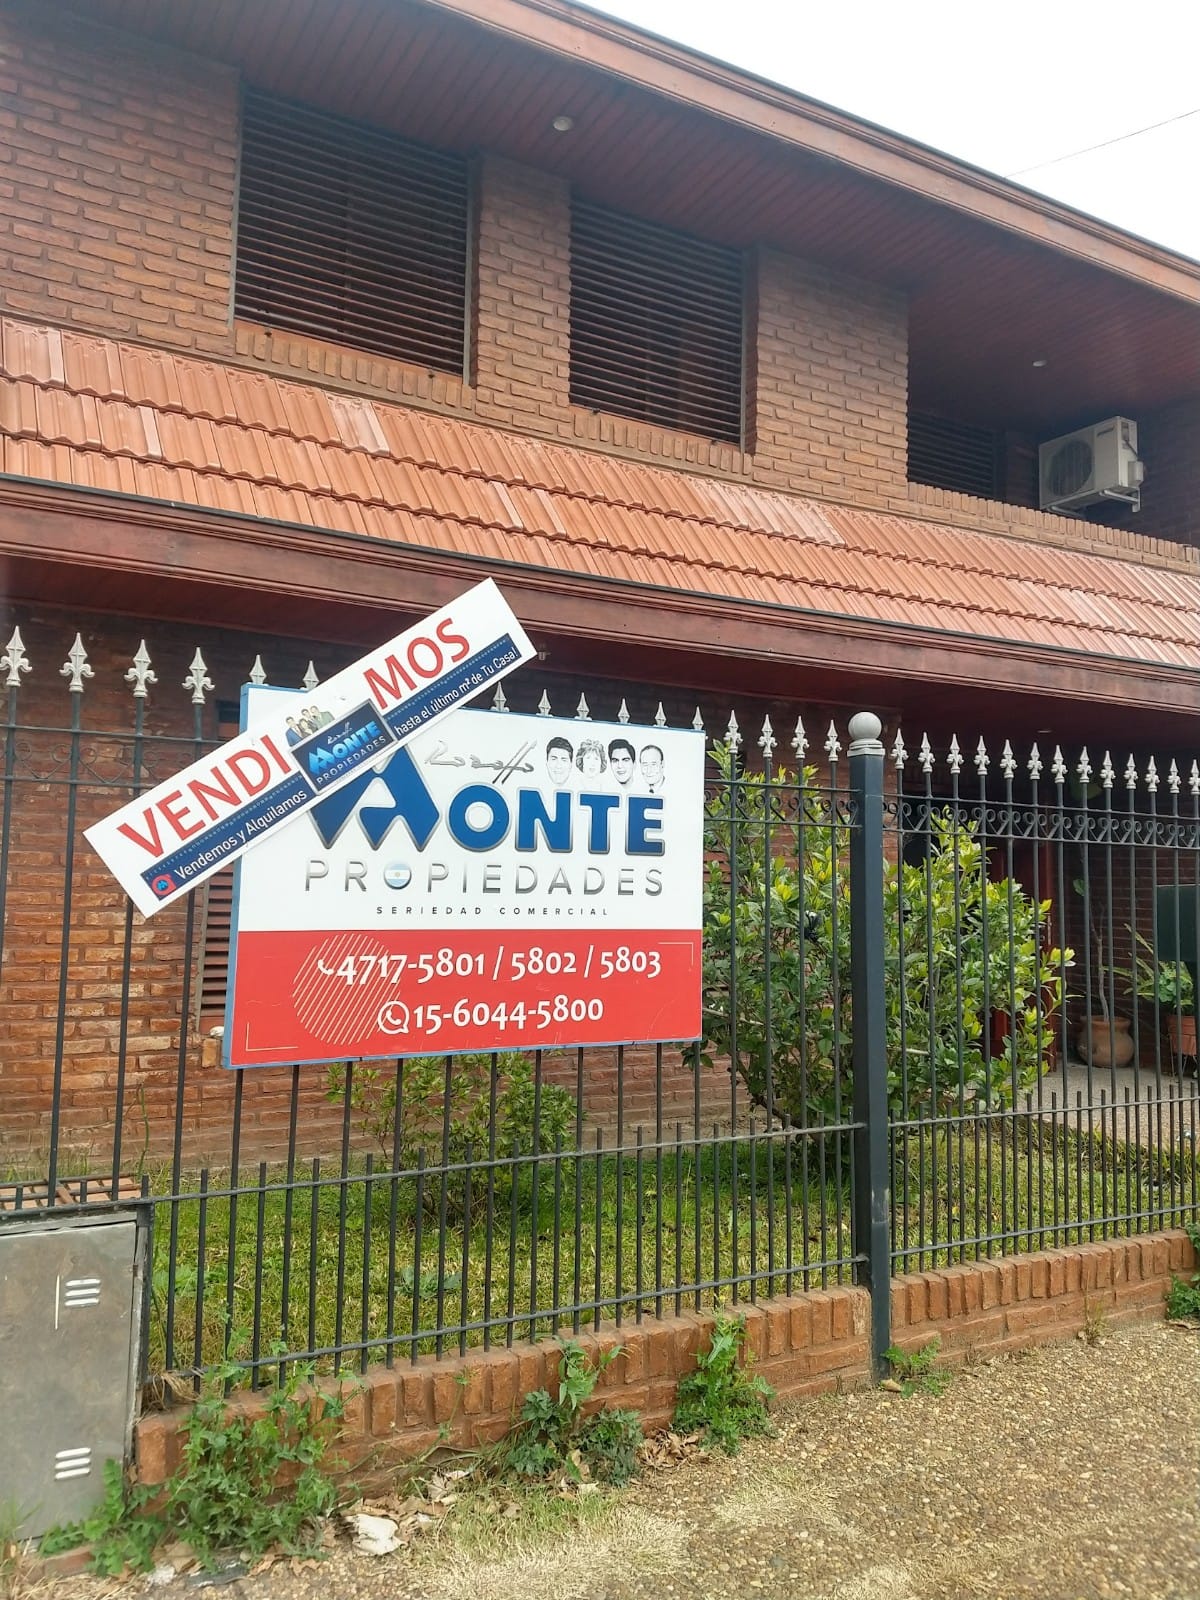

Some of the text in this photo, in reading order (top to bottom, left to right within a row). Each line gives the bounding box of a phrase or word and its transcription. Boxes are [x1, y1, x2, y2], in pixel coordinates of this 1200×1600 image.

[174, 834, 238, 880] Vendemos
[236, 829, 248, 843] y
[245, 789, 307, 836] Alquilamos
[393, 715, 422, 736] hasta
[421, 705, 432, 719] el
[430, 691, 460, 713] último
[470, 672, 483, 685] de
[480, 664, 495, 678] Tu
[492, 647, 519, 669] Casa!
[308, 720, 382, 775] MONTE
[316, 735, 387, 785] PROPIEDADES
[309, 743, 666, 857] MONTE
[304, 859, 664, 898] PROPIEDADES
[376, 905, 609, 917] SERIEDAD COMERCIAL
[336, 947, 485, 986] 4717-5801
[510, 947, 577, 981] 5802
[600, 945, 662, 979] 5803
[413, 994, 604, 1034] 15-6044-5800
